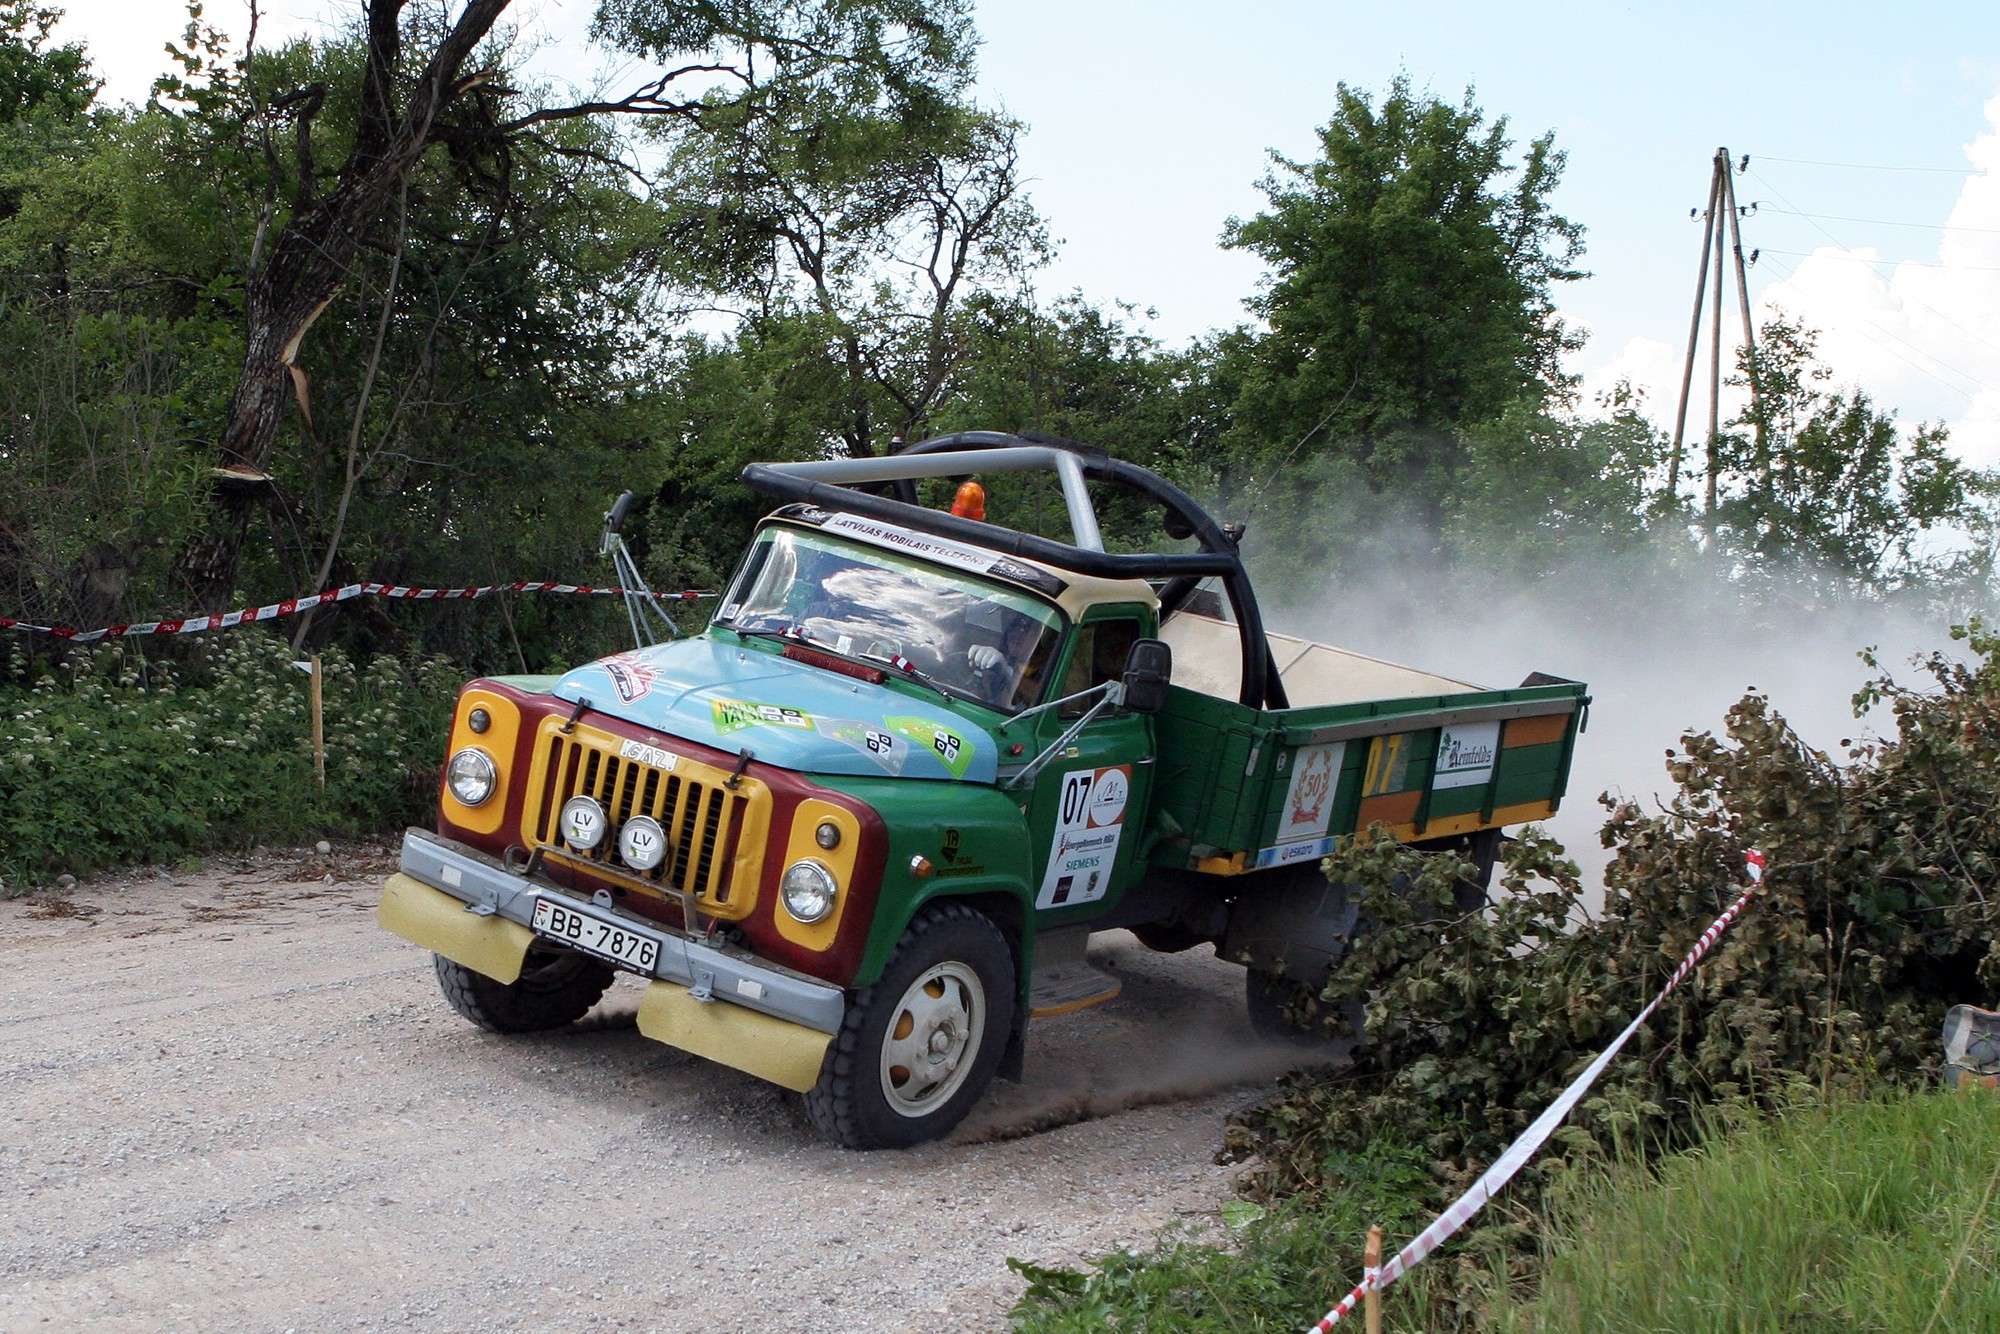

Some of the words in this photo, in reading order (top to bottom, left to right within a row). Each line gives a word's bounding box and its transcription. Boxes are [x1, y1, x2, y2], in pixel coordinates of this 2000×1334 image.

[834, 519, 882, 537] LATVIJAS
[882, 532, 931, 551] MOBILAIS
[933, 546, 988, 566] TELEFONS
[627, 743, 667, 770] GAZ
[1362, 734, 1402, 798] 07
[1303, 773, 1322, 797] 50
[1063, 776, 1092, 825] 07
[574, 811, 593, 826] LV
[632, 831, 653, 847] LV
[1065, 855, 1101, 871] SIEMENS
[549, 907, 655, 966] BB-7876
